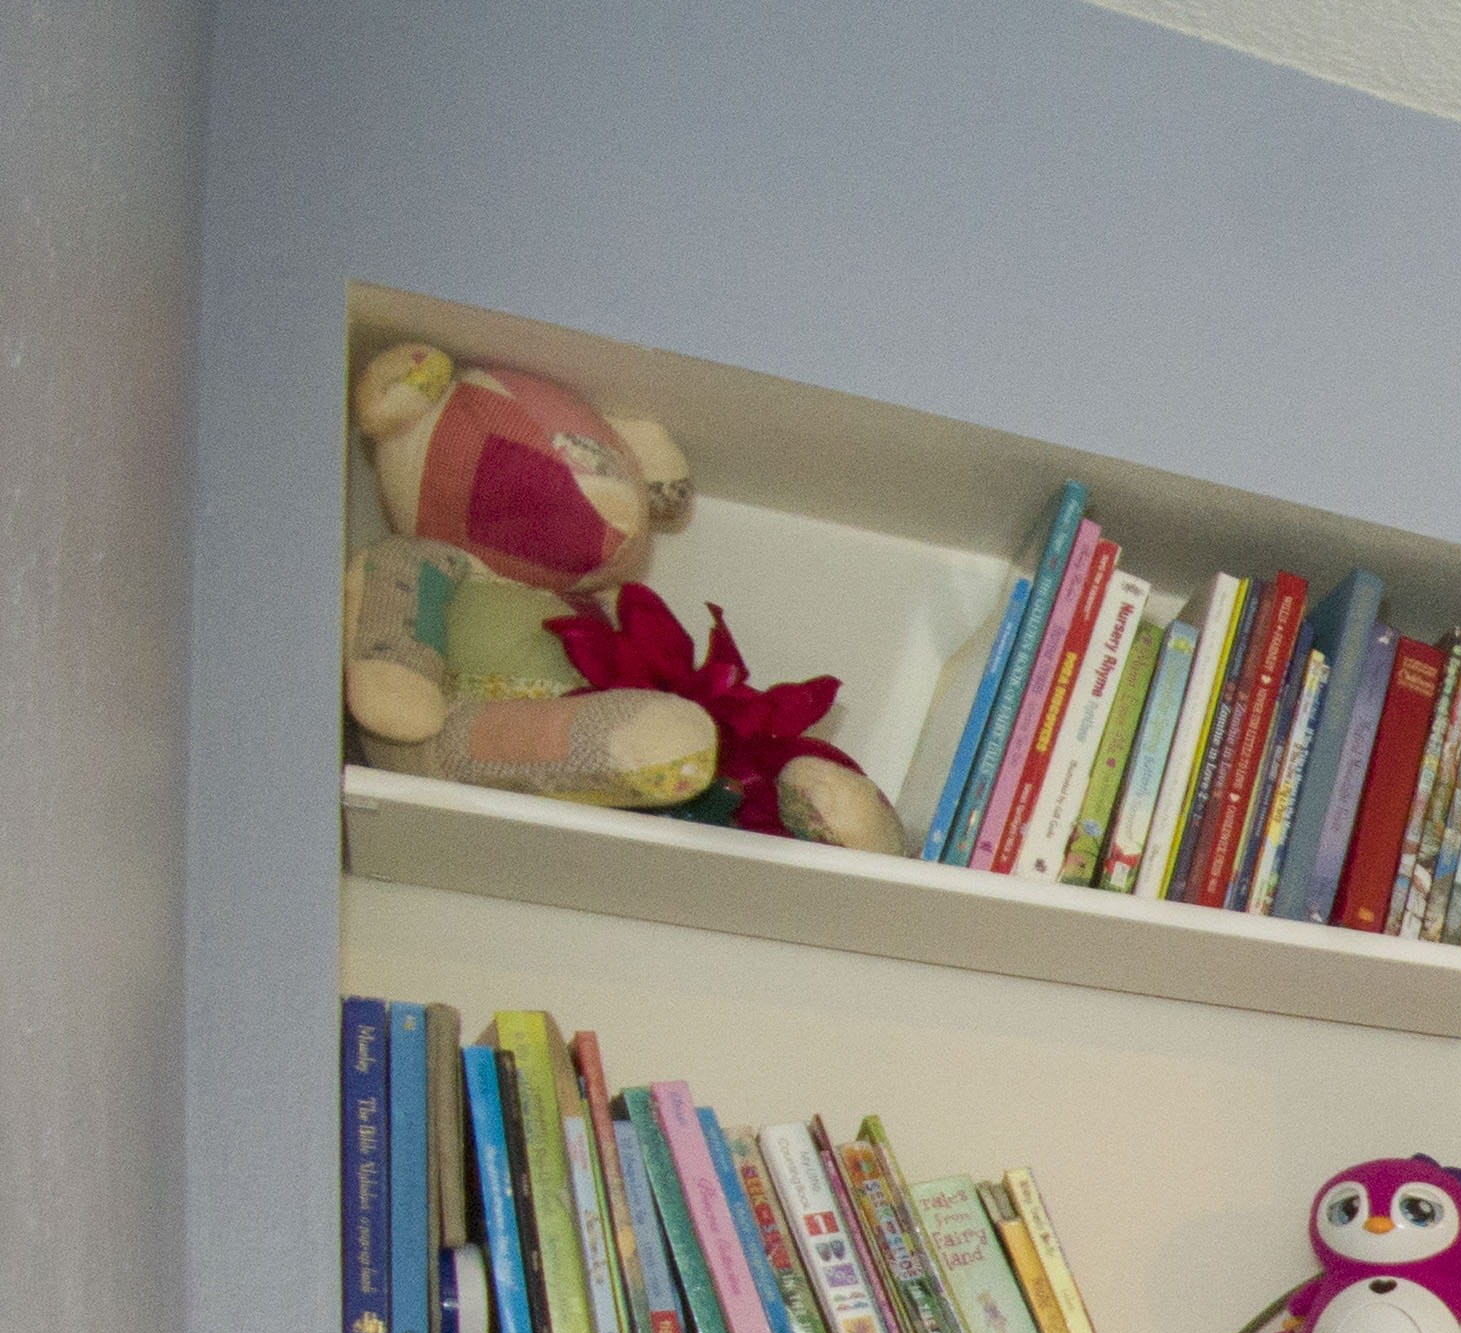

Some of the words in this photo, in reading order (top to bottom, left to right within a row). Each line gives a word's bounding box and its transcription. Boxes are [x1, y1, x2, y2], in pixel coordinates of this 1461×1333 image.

[1018, 597, 1047, 653] GOLDEN
[1102, 599, 1136, 654] Nursery
[1007, 651, 1030, 689] BOOK
[1056, 650, 1078, 685] DORA
[1086, 651, 1120, 701] Rhyme
[989, 704, 1013, 743] FAIRY
[1034, 684, 1068, 754] DISCOVERS
[1209, 701, 1231, 746] Zombie
[1225, 700, 1247, 745] Zombie
[978, 739, 1002, 777] TALES
[1206, 746, 1219, 761] in
[1221, 744, 1236, 760] in
[1198, 761, 1215, 790] Love
[1214, 760, 1232, 790] Love
[1231, 765, 1248, 790] LOVE
[357, 1096, 376, 1121] The
[358, 1124, 376, 1154] Bible
[738, 1164, 768, 1207] SEEK
[862, 1177, 895, 1224] SEEK
[918, 1187, 969, 1210] Tales
[934, 1210, 974, 1229] from
[932, 1228, 989, 1251] Fairy
[940, 1245, 985, 1272] land
[360, 1266, 377, 1294] book
